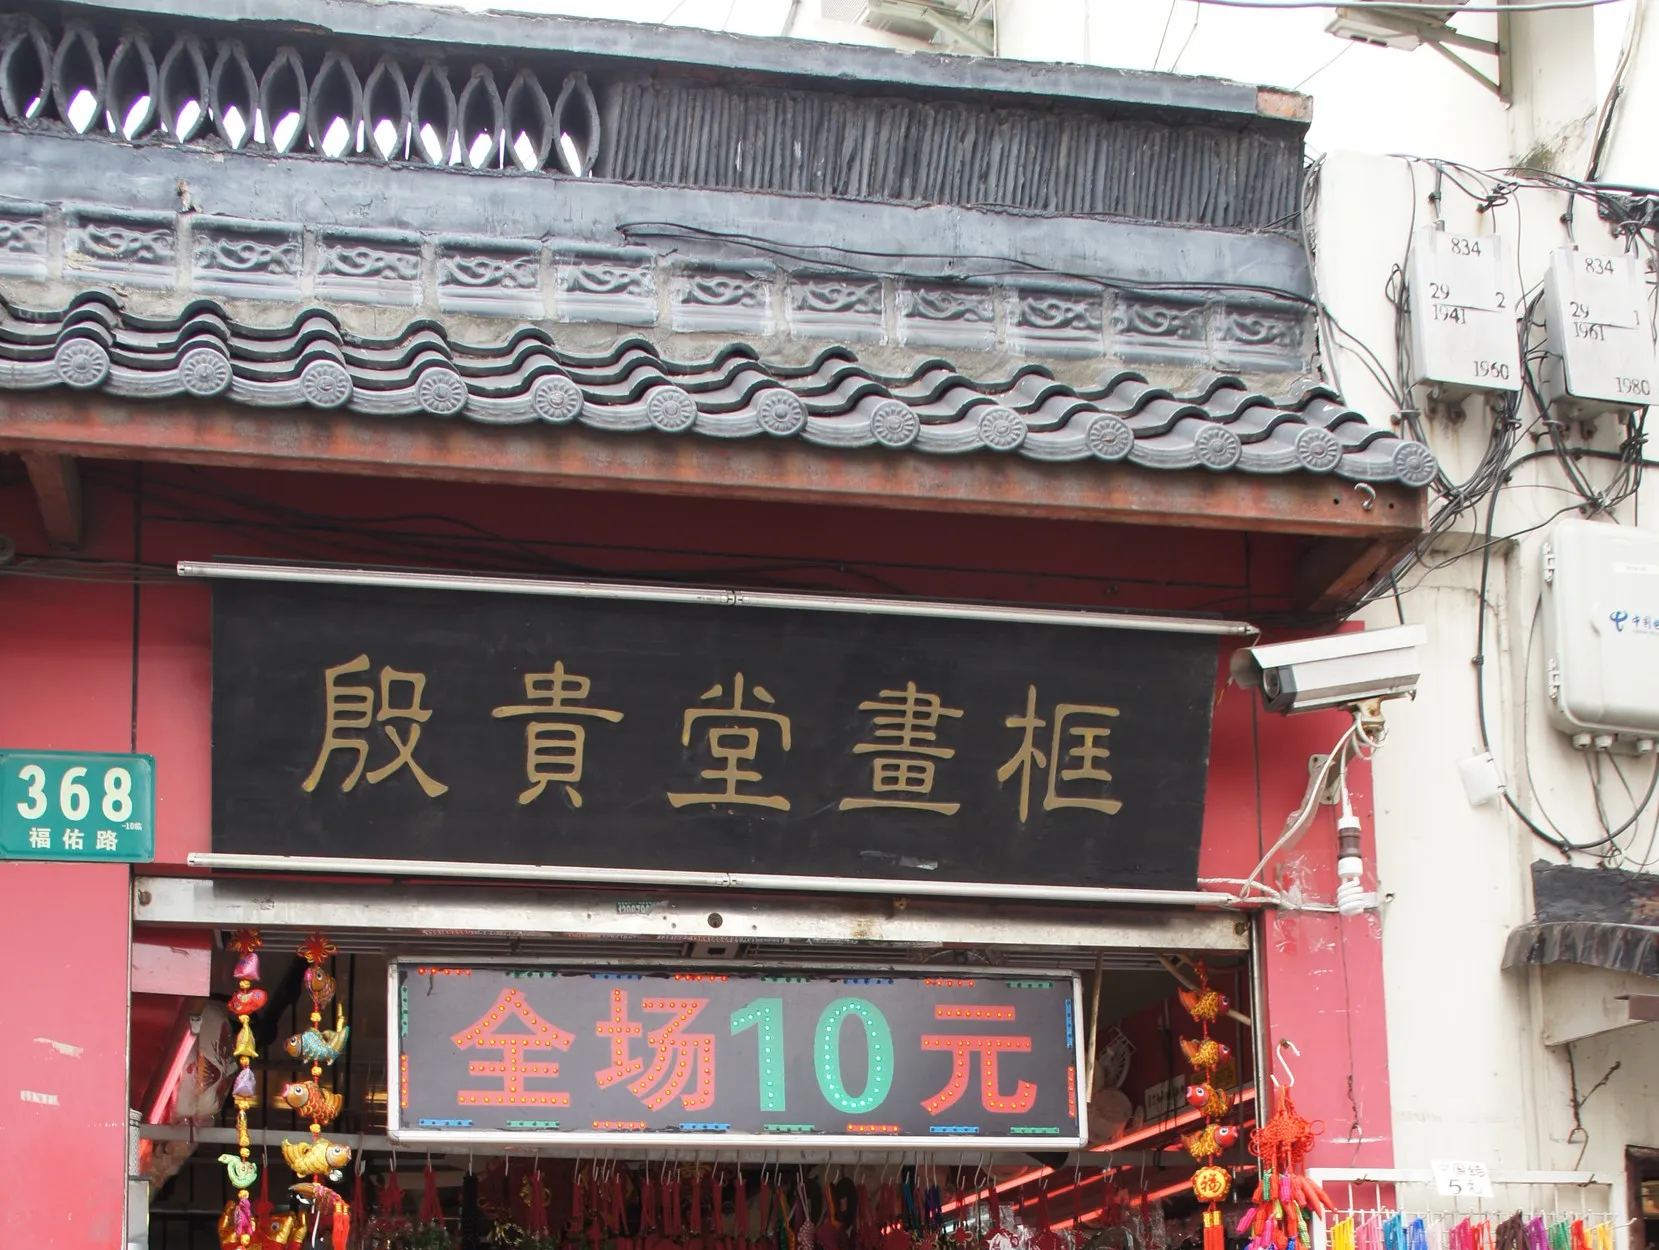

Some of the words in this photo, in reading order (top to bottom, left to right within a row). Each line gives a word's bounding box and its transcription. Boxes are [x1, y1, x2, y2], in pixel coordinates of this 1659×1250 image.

[1451, 237, 1481, 257] 834
[1585, 257, 1614, 276] 834
[1429, 282, 1450, 300] 29
[1495, 291, 1506, 308] 2
[1432, 304, 1466, 325] 1941
[1570, 301, 1589, 318] 29
[1573, 321, 1605, 341] 1961
[1473, 360, 1509, 380] 1960
[1615, 376, 1650, 396] 1980
[17, 764, 133, 822] 368
[29, 827, 118, 851] 福佑路
[449, 988, 1038, 1116] 全场10元
[1449, 1179, 1483, 1195] 5元
